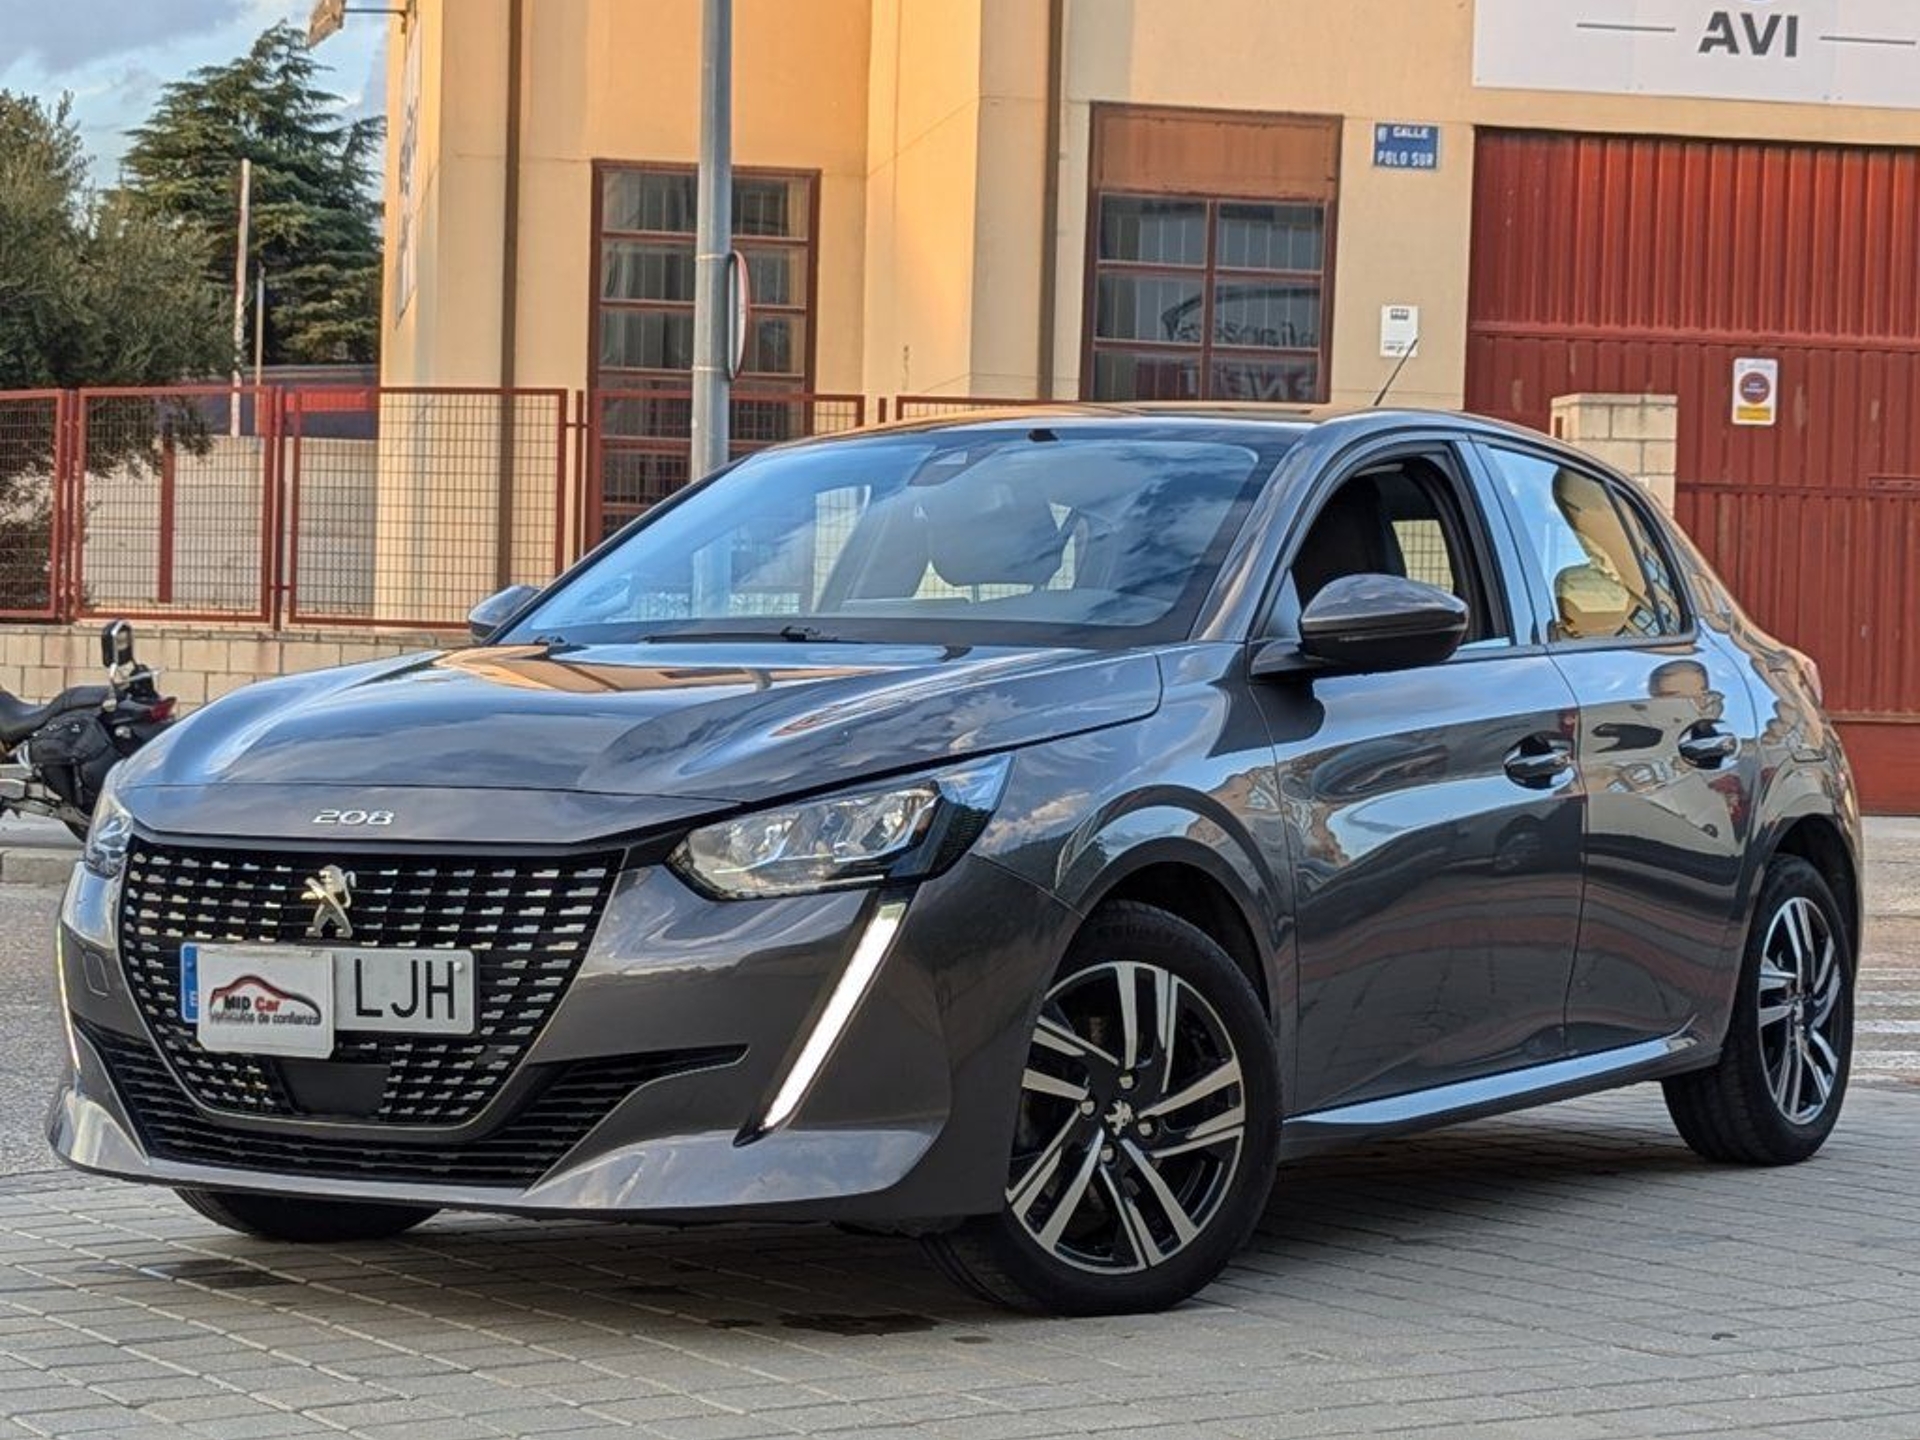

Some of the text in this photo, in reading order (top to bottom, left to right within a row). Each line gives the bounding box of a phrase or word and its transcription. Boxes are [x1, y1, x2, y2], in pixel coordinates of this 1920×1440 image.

[1698, 11, 1798, 57] AVI
[1393, 126, 1429, 139] CALLE
[1378, 150, 1434, 166] POLO SUR
[312, 810, 395, 825] 208
[354, 958, 455, 1019] LJH
[255, 997, 281, 1012] Car
[258, 1012, 271, 1025] de
[273, 1011, 322, 1026] confianza
